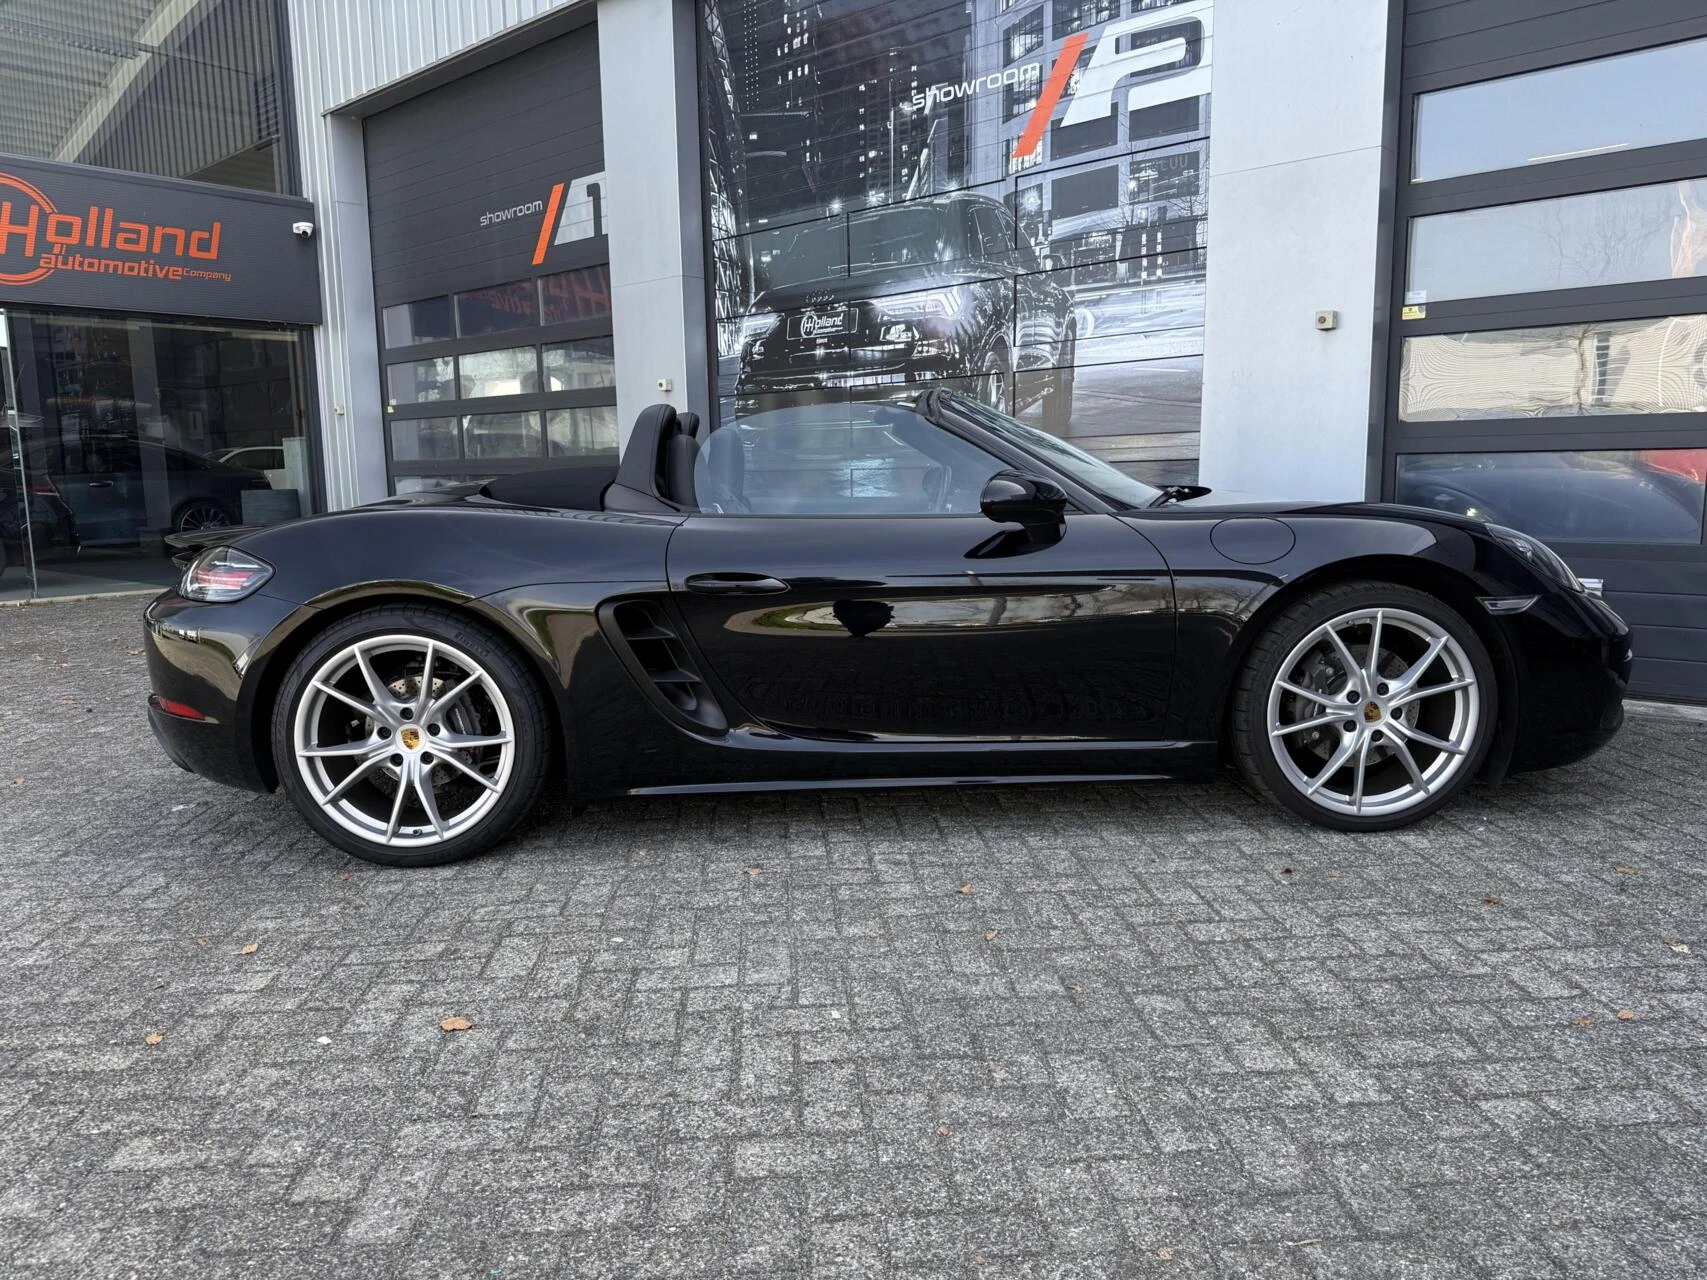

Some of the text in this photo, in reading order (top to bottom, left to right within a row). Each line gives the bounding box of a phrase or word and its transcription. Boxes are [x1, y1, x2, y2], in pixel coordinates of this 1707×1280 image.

[912, 62, 1040, 111] showroom
[0, 200, 222, 260] Holland
[480, 200, 543, 227] showroom
[39, 253, 232, 282] automotive Company
